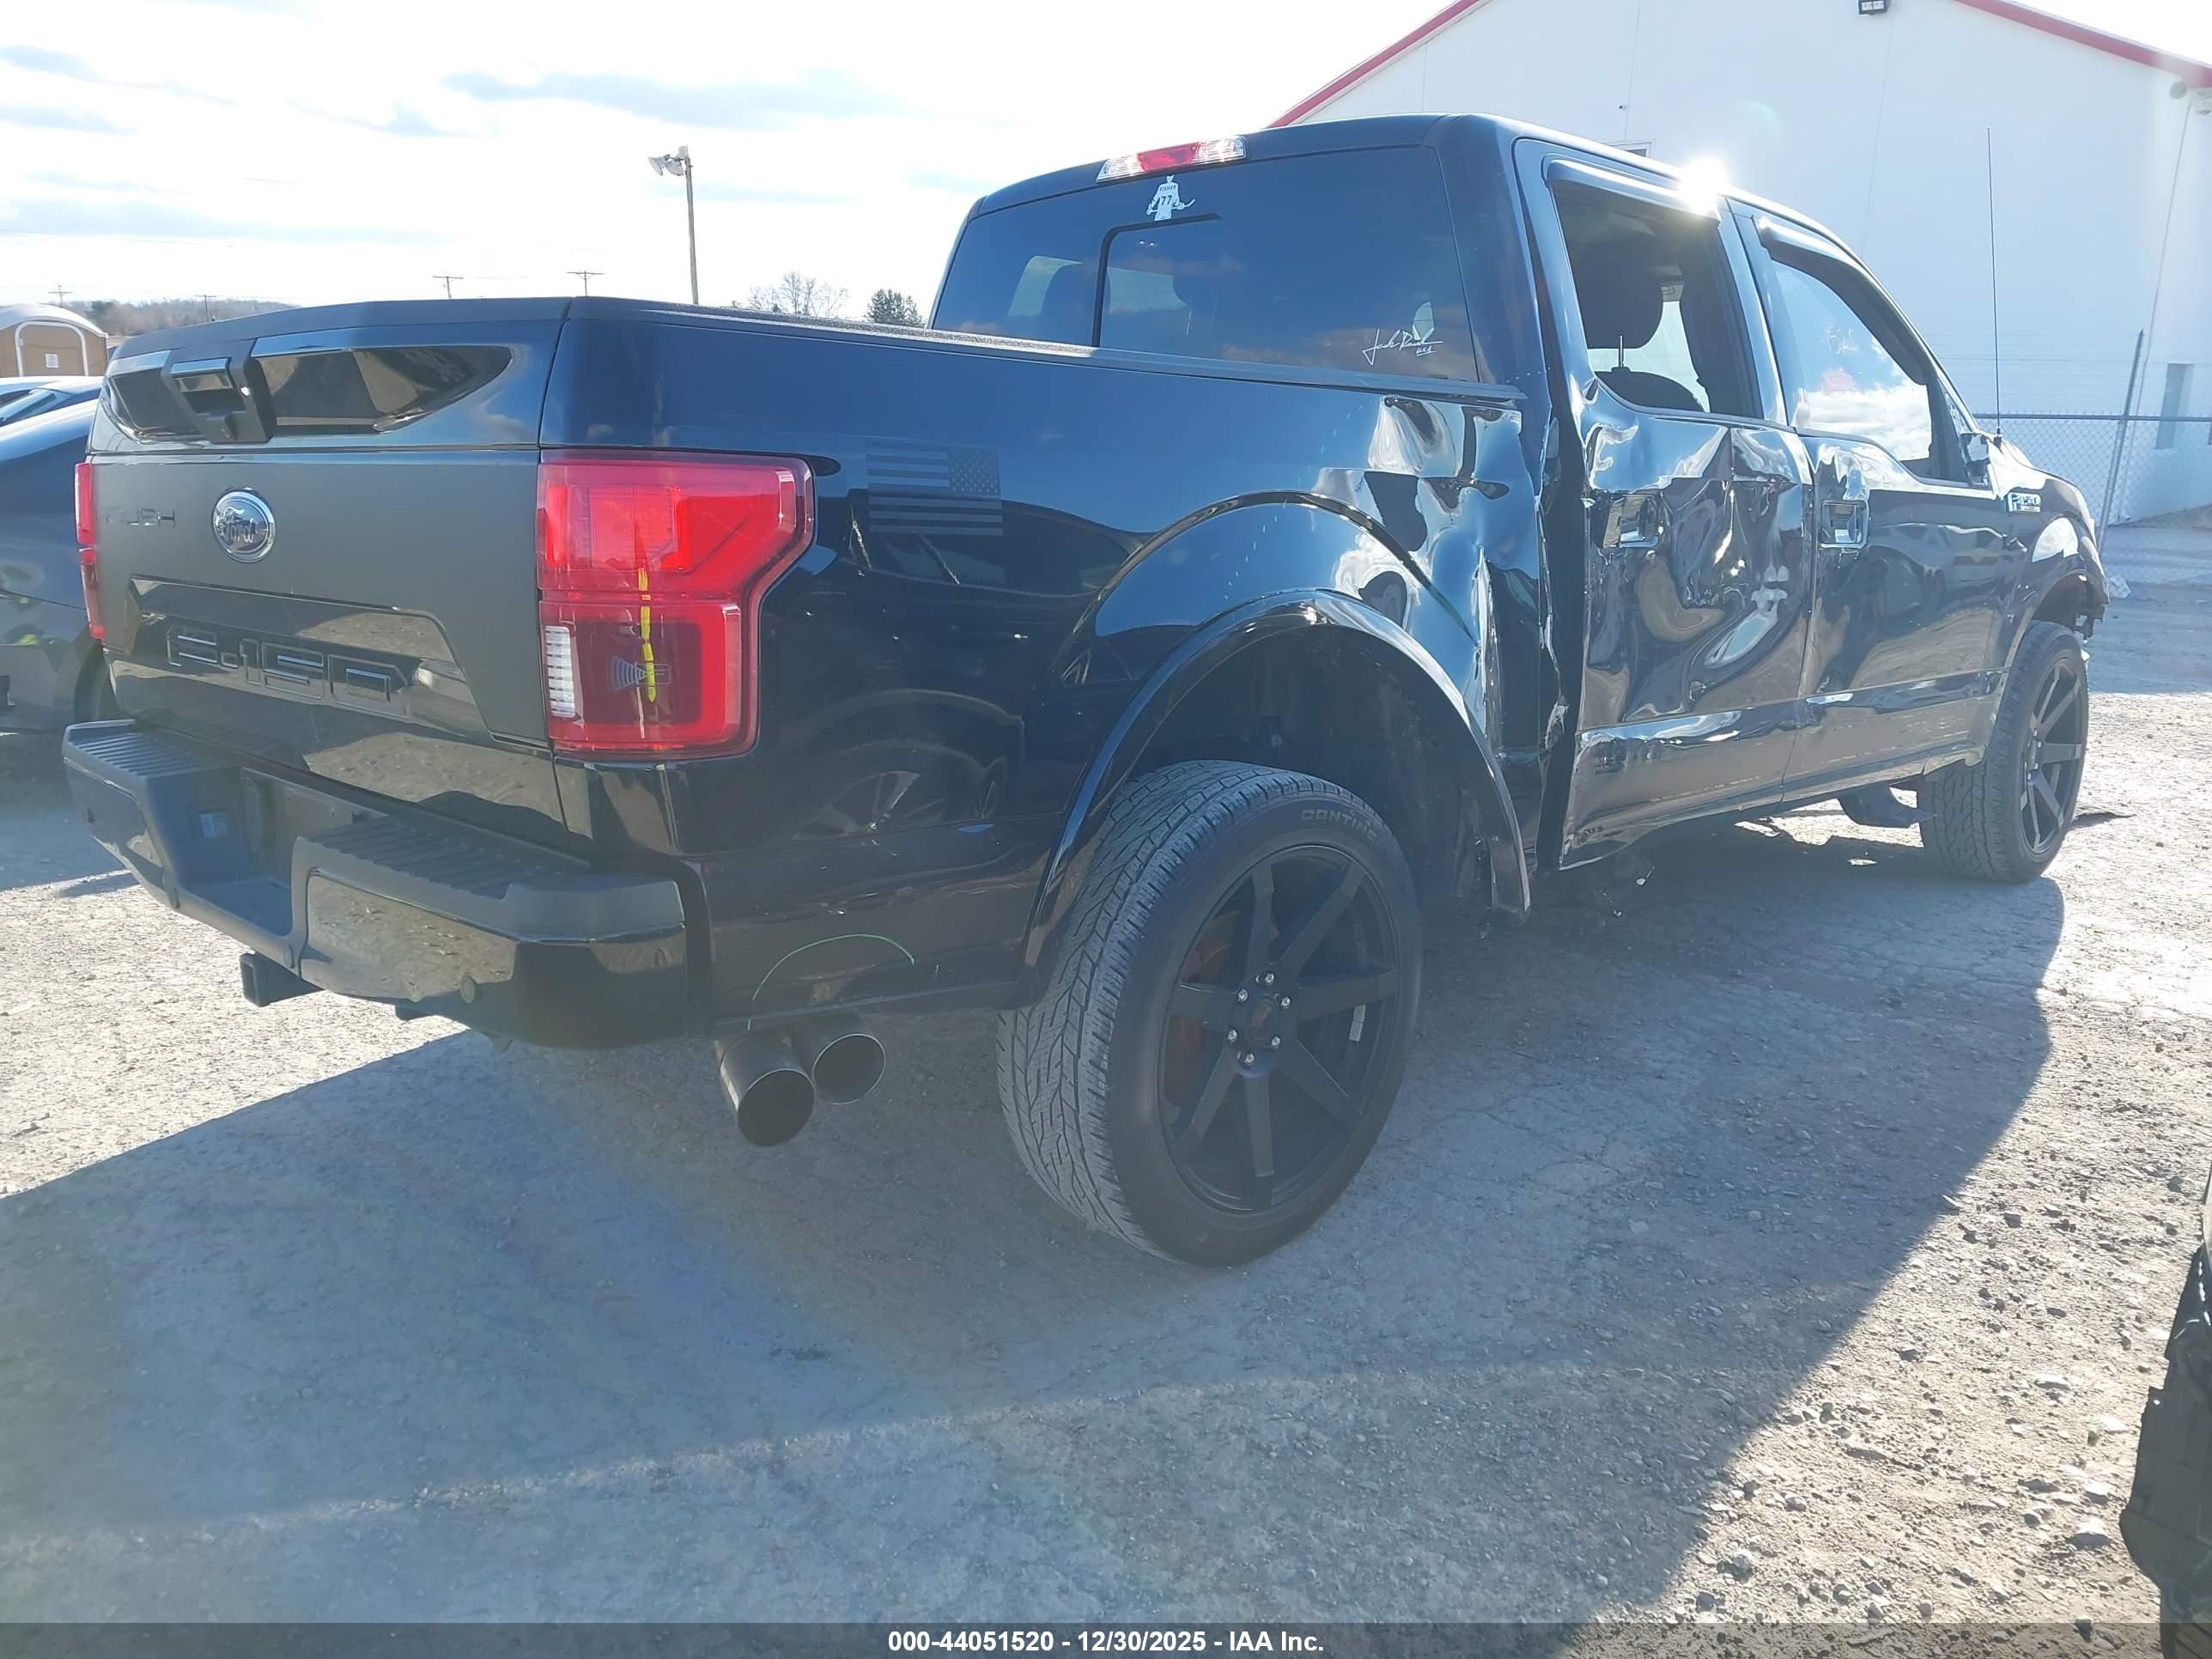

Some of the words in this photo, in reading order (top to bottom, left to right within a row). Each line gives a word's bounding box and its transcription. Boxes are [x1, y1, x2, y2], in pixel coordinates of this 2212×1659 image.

[1161, 195, 1173, 206] 77
[221, 506, 255, 544] Ford
[166, 624, 412, 720] F-150
